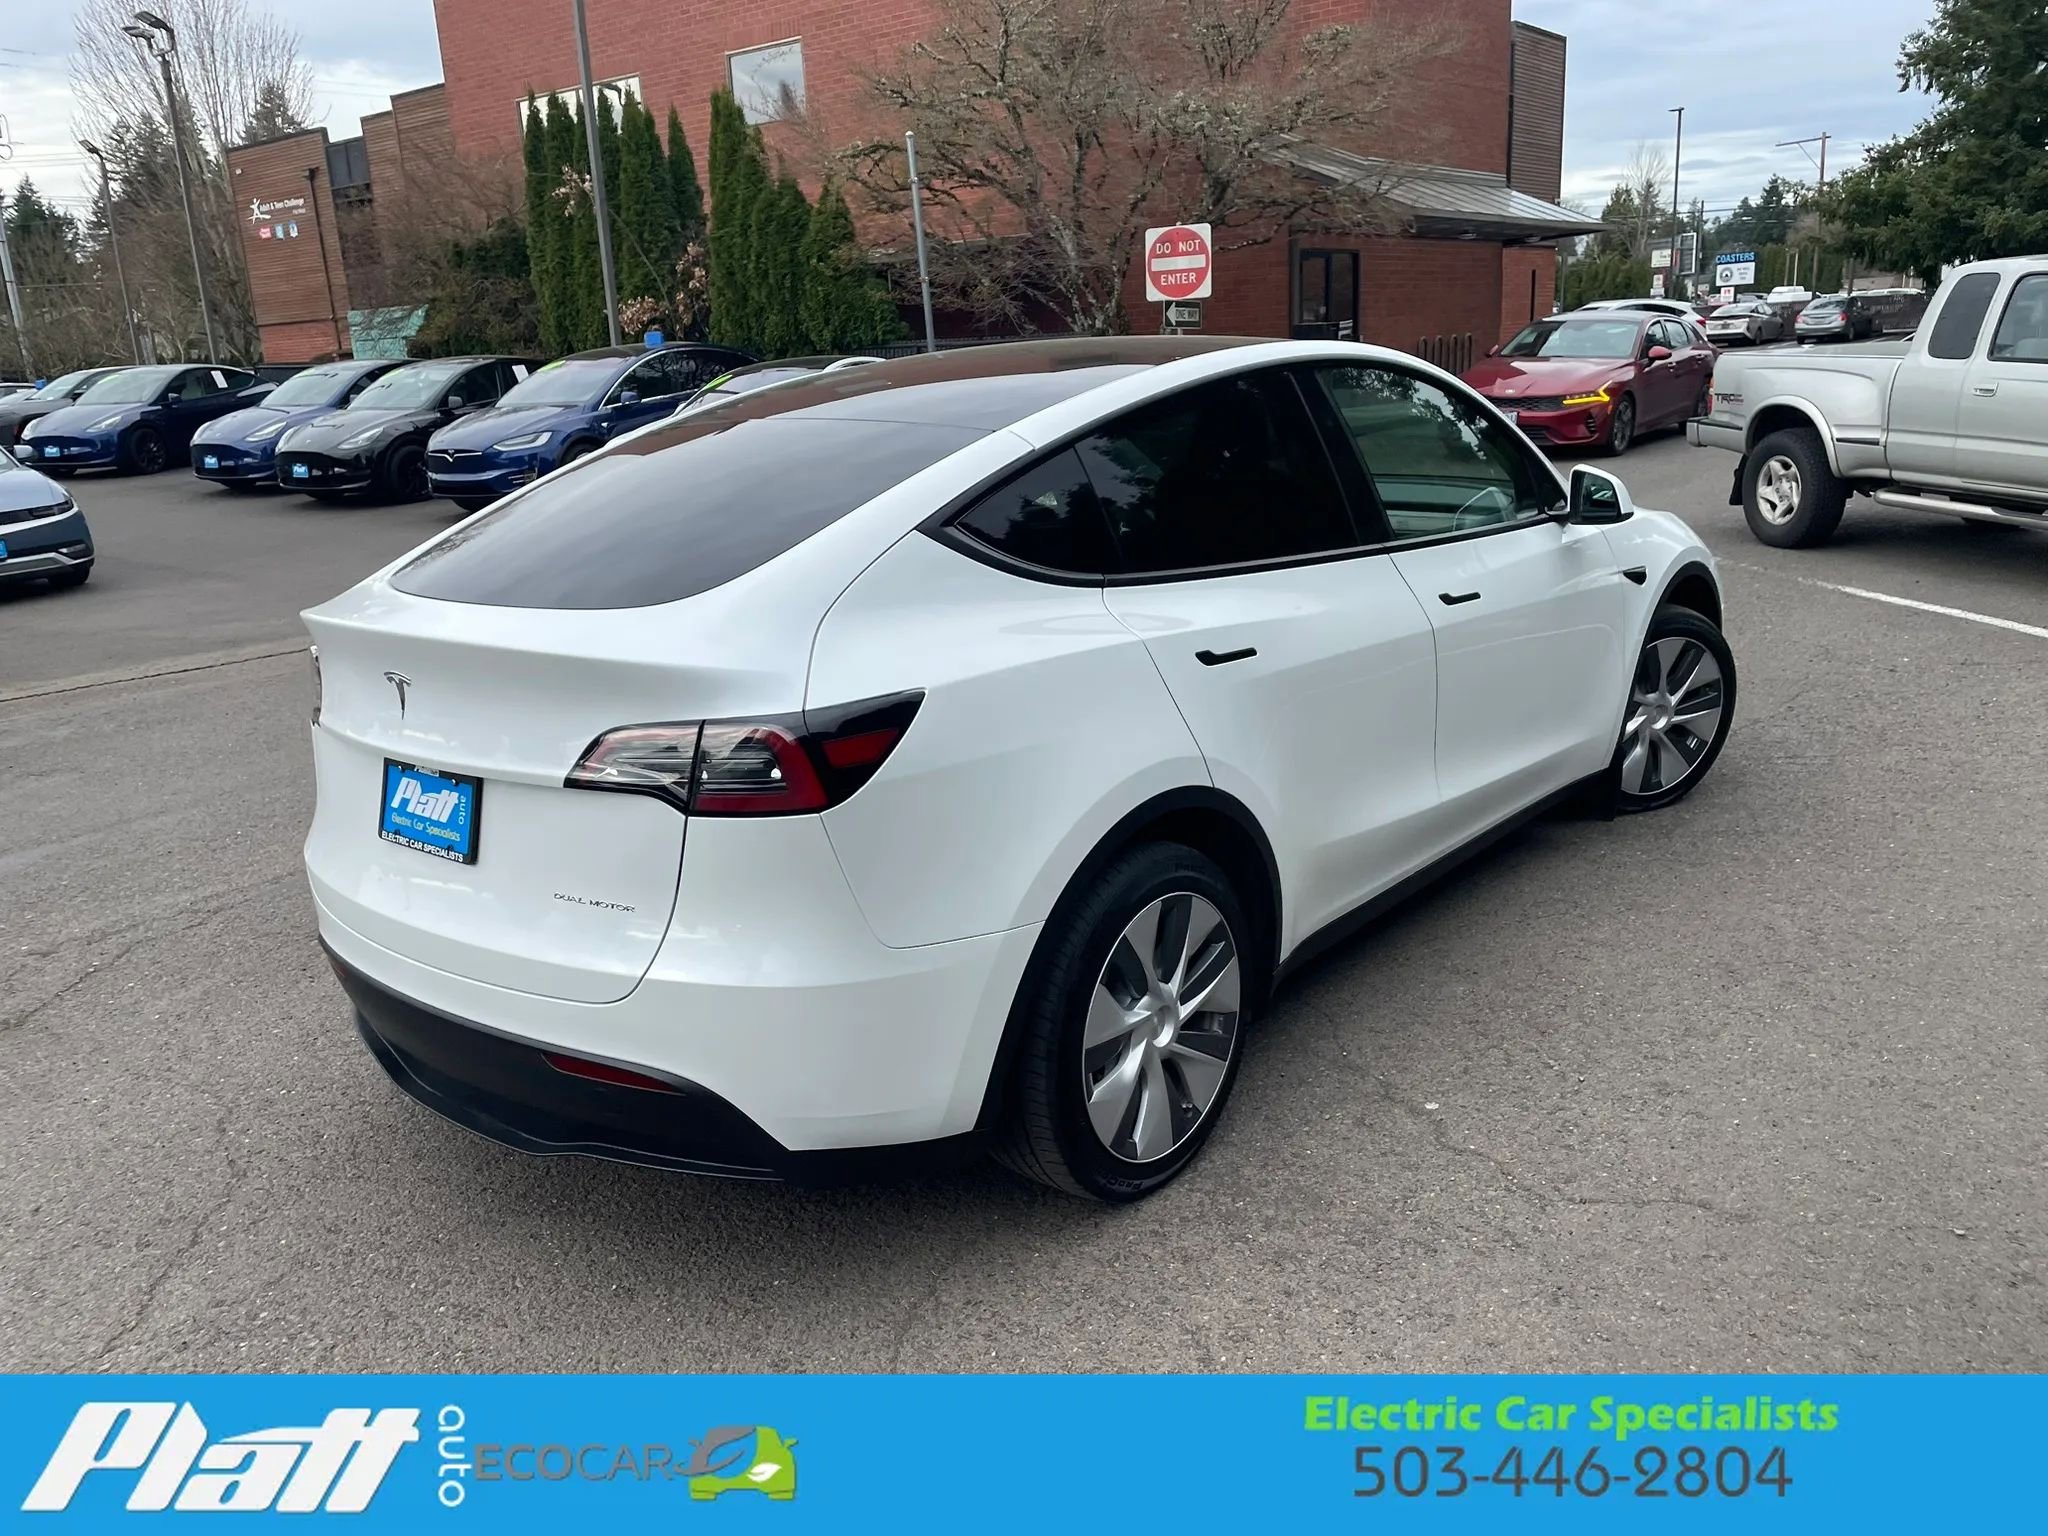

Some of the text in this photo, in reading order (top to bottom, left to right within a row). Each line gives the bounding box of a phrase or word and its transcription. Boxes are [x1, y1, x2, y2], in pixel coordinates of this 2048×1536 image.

[1156, 239, 1200, 254] DO NOT
[1715, 252, 1755, 263] COASTERS
[1160, 272, 1196, 285] ENTER
[1175, 309, 1198, 320] ONE WAY
[390, 776, 460, 823] Platt
[458, 795, 467, 825] auto
[391, 812, 461, 841] Electric Car Specialists
[381, 830, 464, 862] ELECTRIC CAR SPECIALISTS
[553, 892, 635, 912] DUAL MOTOR
